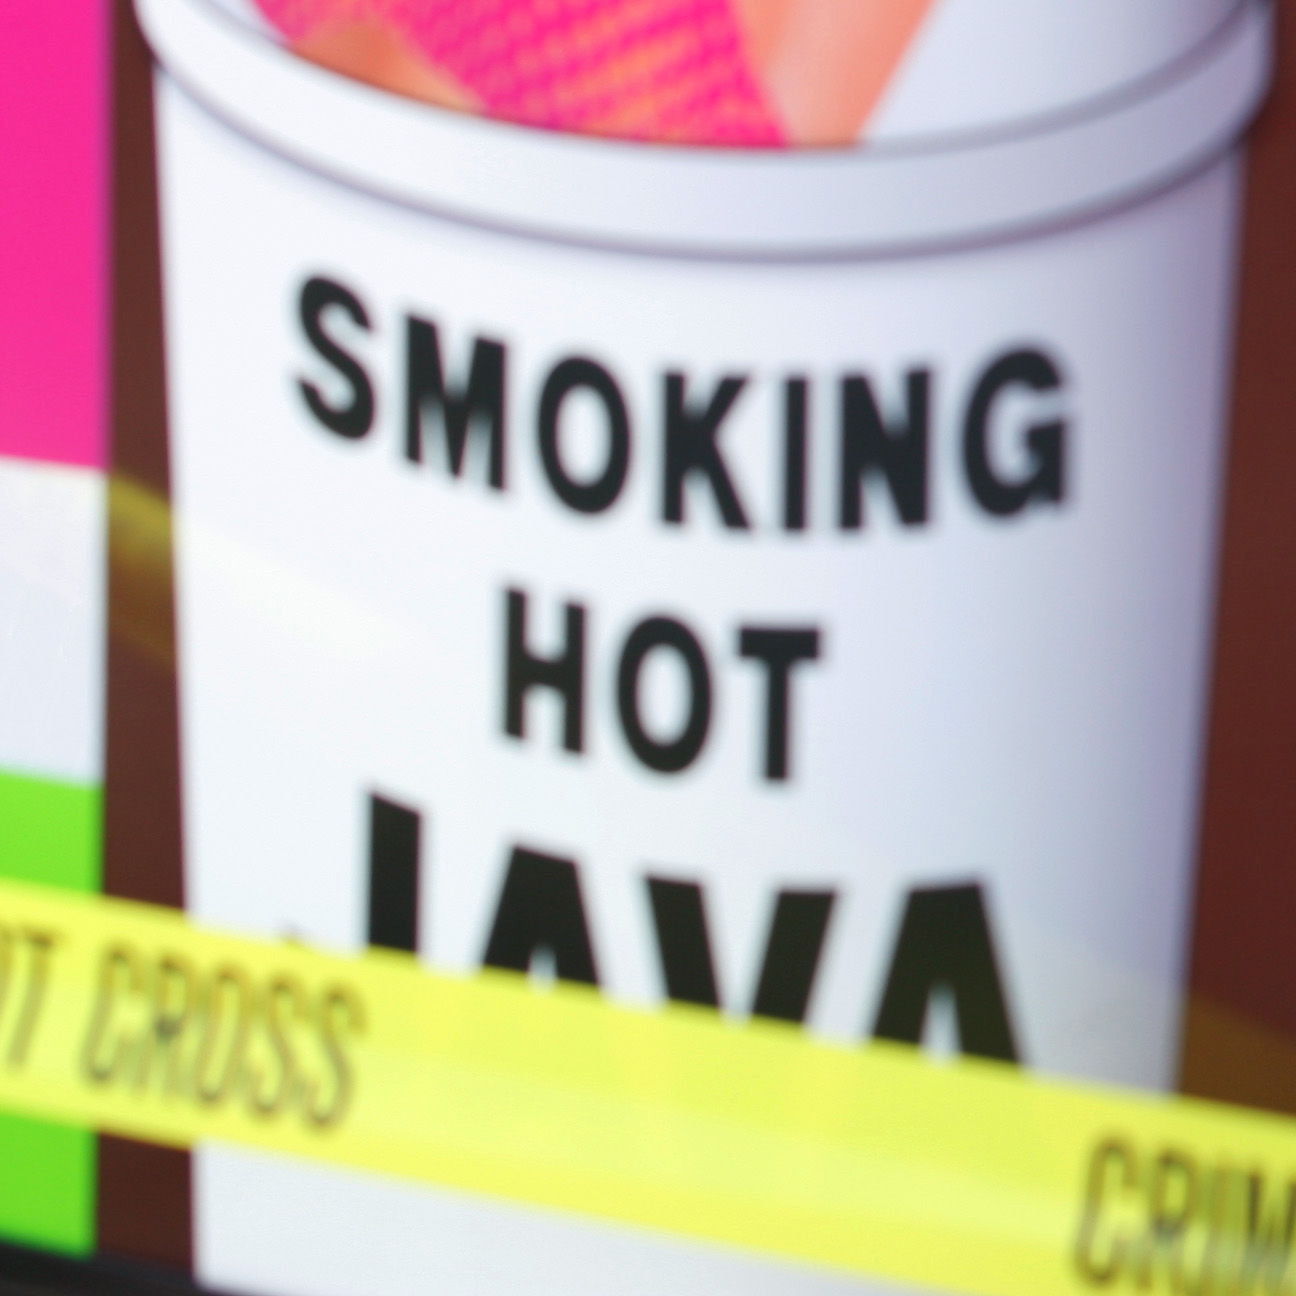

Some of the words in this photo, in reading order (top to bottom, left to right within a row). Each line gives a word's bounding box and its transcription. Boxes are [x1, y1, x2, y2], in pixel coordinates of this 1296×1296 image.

[295, 274, 1074, 534] SMOKING
[501, 585, 823, 784] HOT
[80, 940, 367, 1135] CROSS
